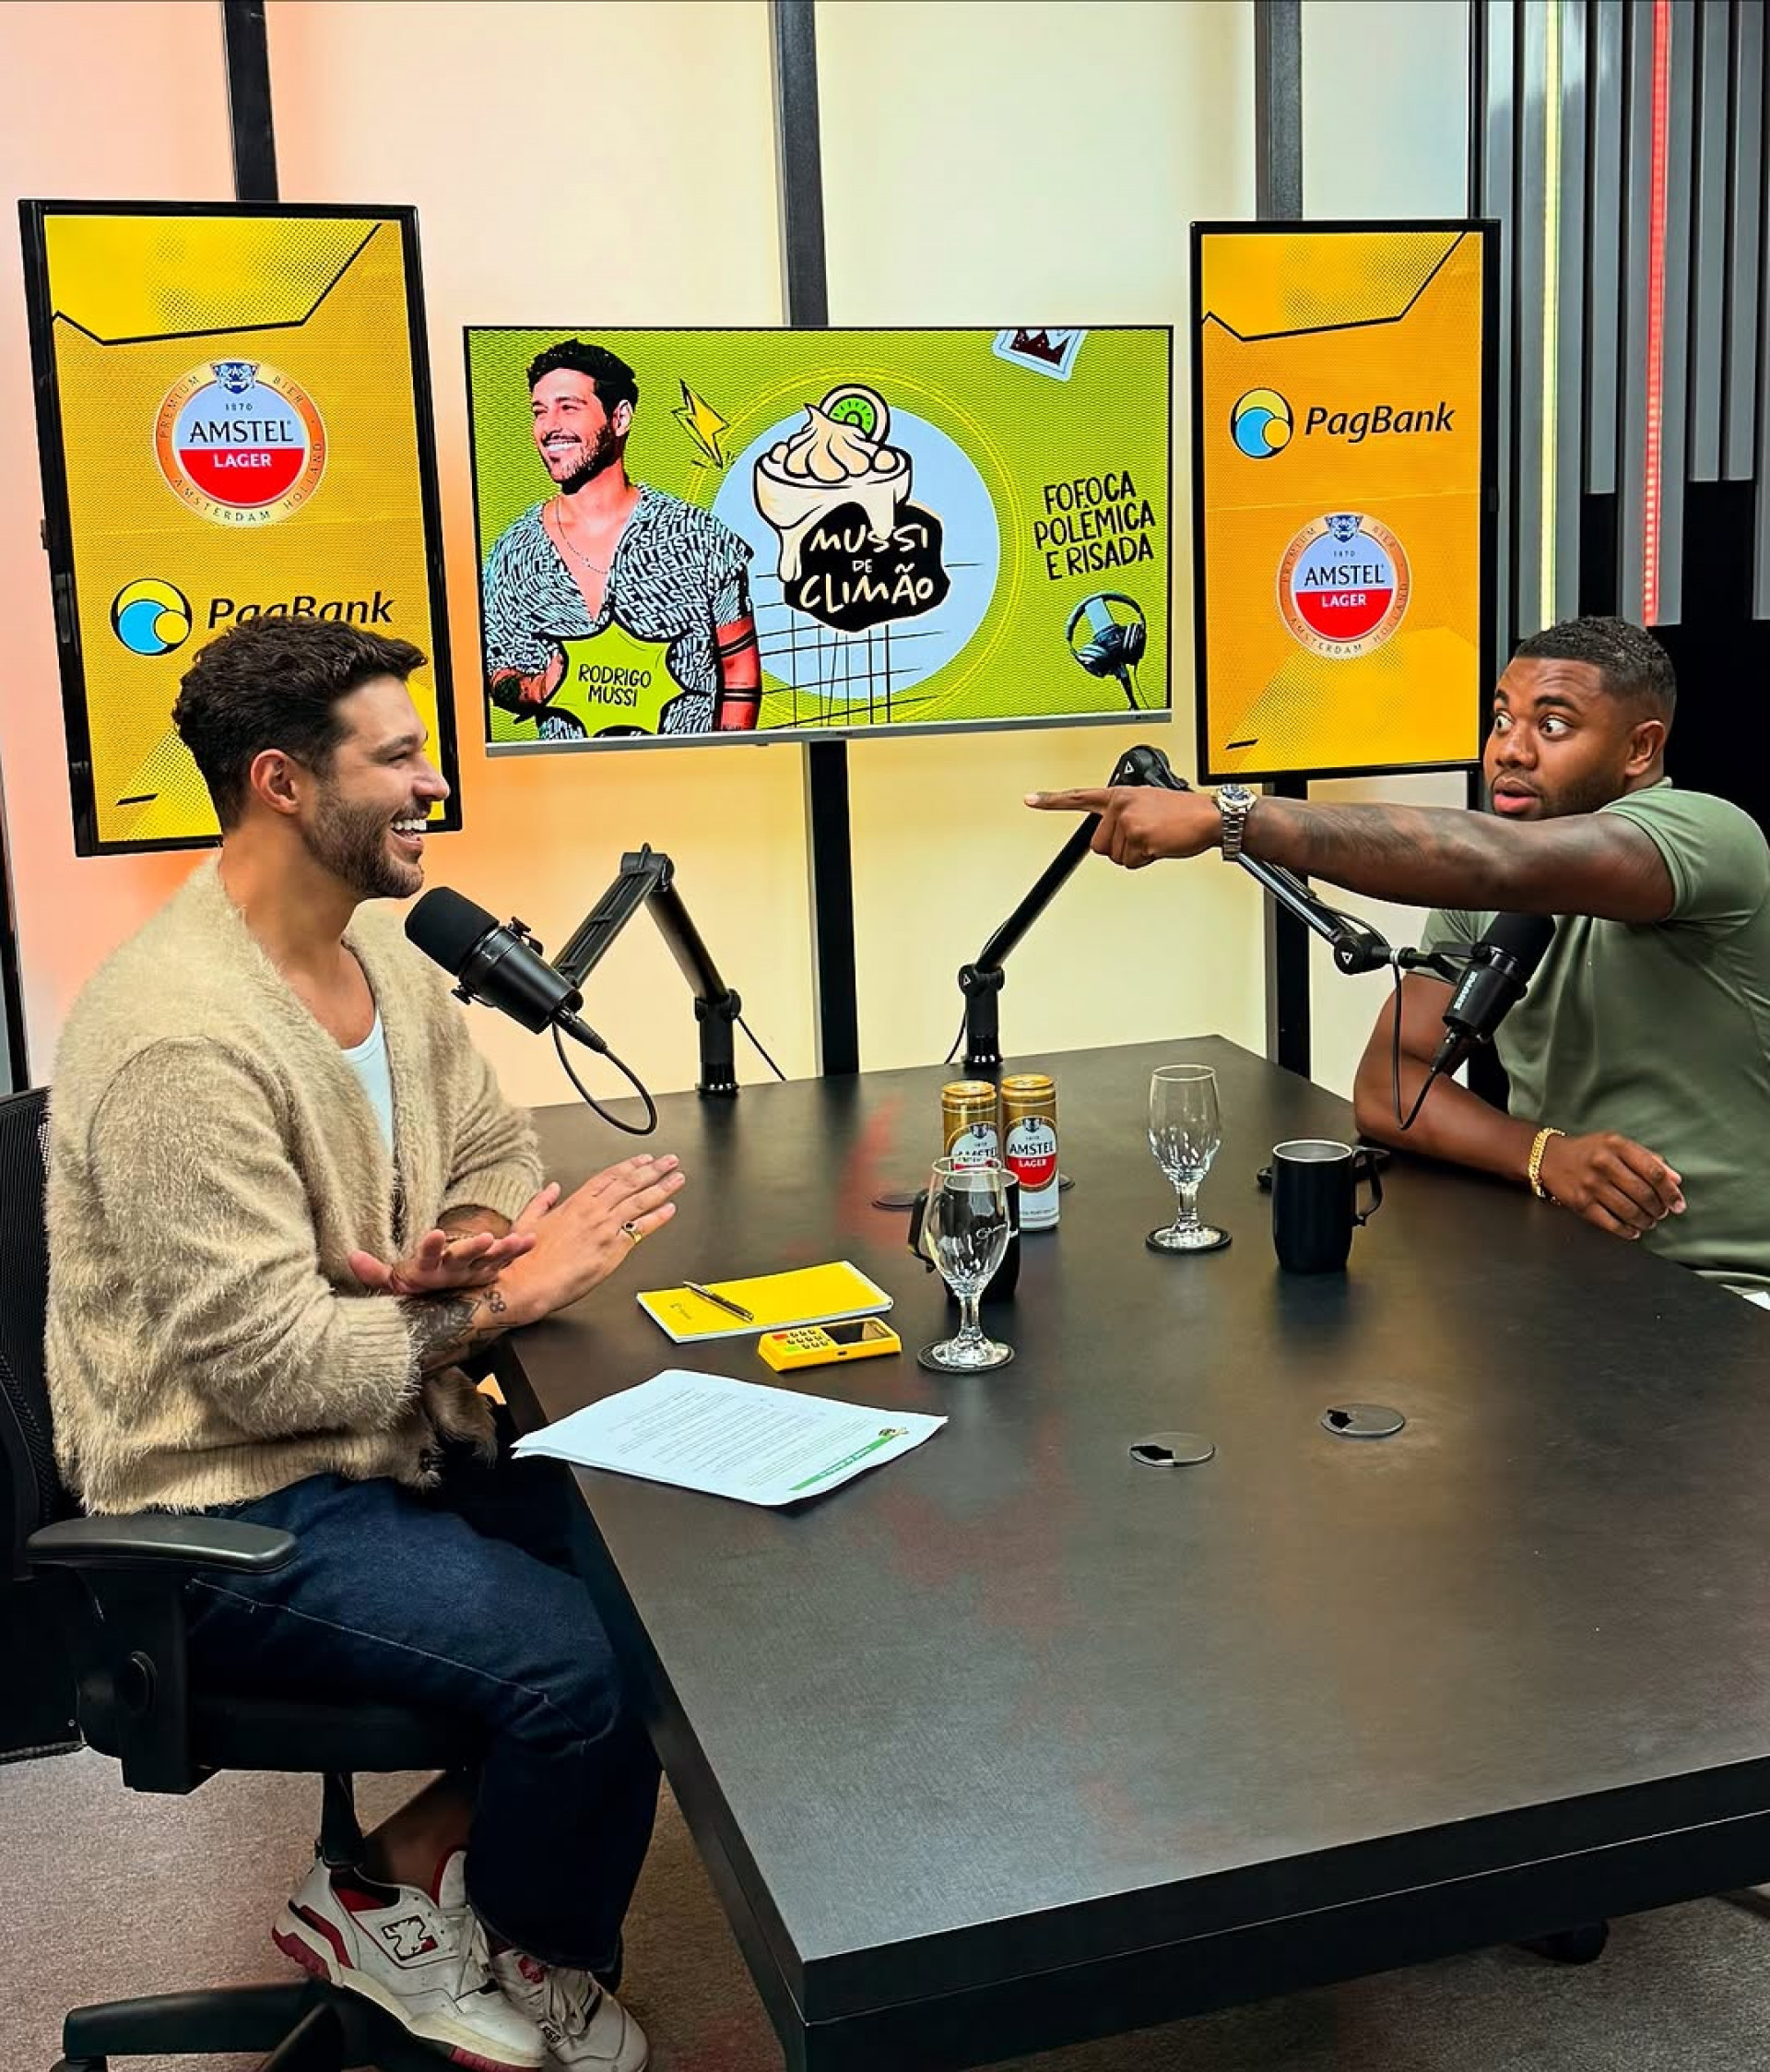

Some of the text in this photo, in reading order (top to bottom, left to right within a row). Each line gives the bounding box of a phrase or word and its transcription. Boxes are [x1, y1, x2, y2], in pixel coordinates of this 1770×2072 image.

[189, 420, 293, 444] AMSTEL
[1304, 401, 1456, 444] PagBank
[213, 453, 272, 468] LAGER
[173, 479, 271, 522] AMSTERDAM
[1044, 470, 1136, 515] FOFOCA
[809, 523, 928, 553] MUSSI
[852, 559, 873, 573] DE
[1046, 532, 1154, 580] E RISADA
[1304, 564, 1385, 586] AMSTEL
[799, 562, 935, 614] CLIMÃO
[1321, 593, 1367, 608] LAGER
[578, 663, 652, 689] RODRIGO
[587, 685, 637, 707] MUSSI
[1009, 1141, 1054, 1155] AMSTEL
[1019, 1157, 1047, 1168] LAGER
